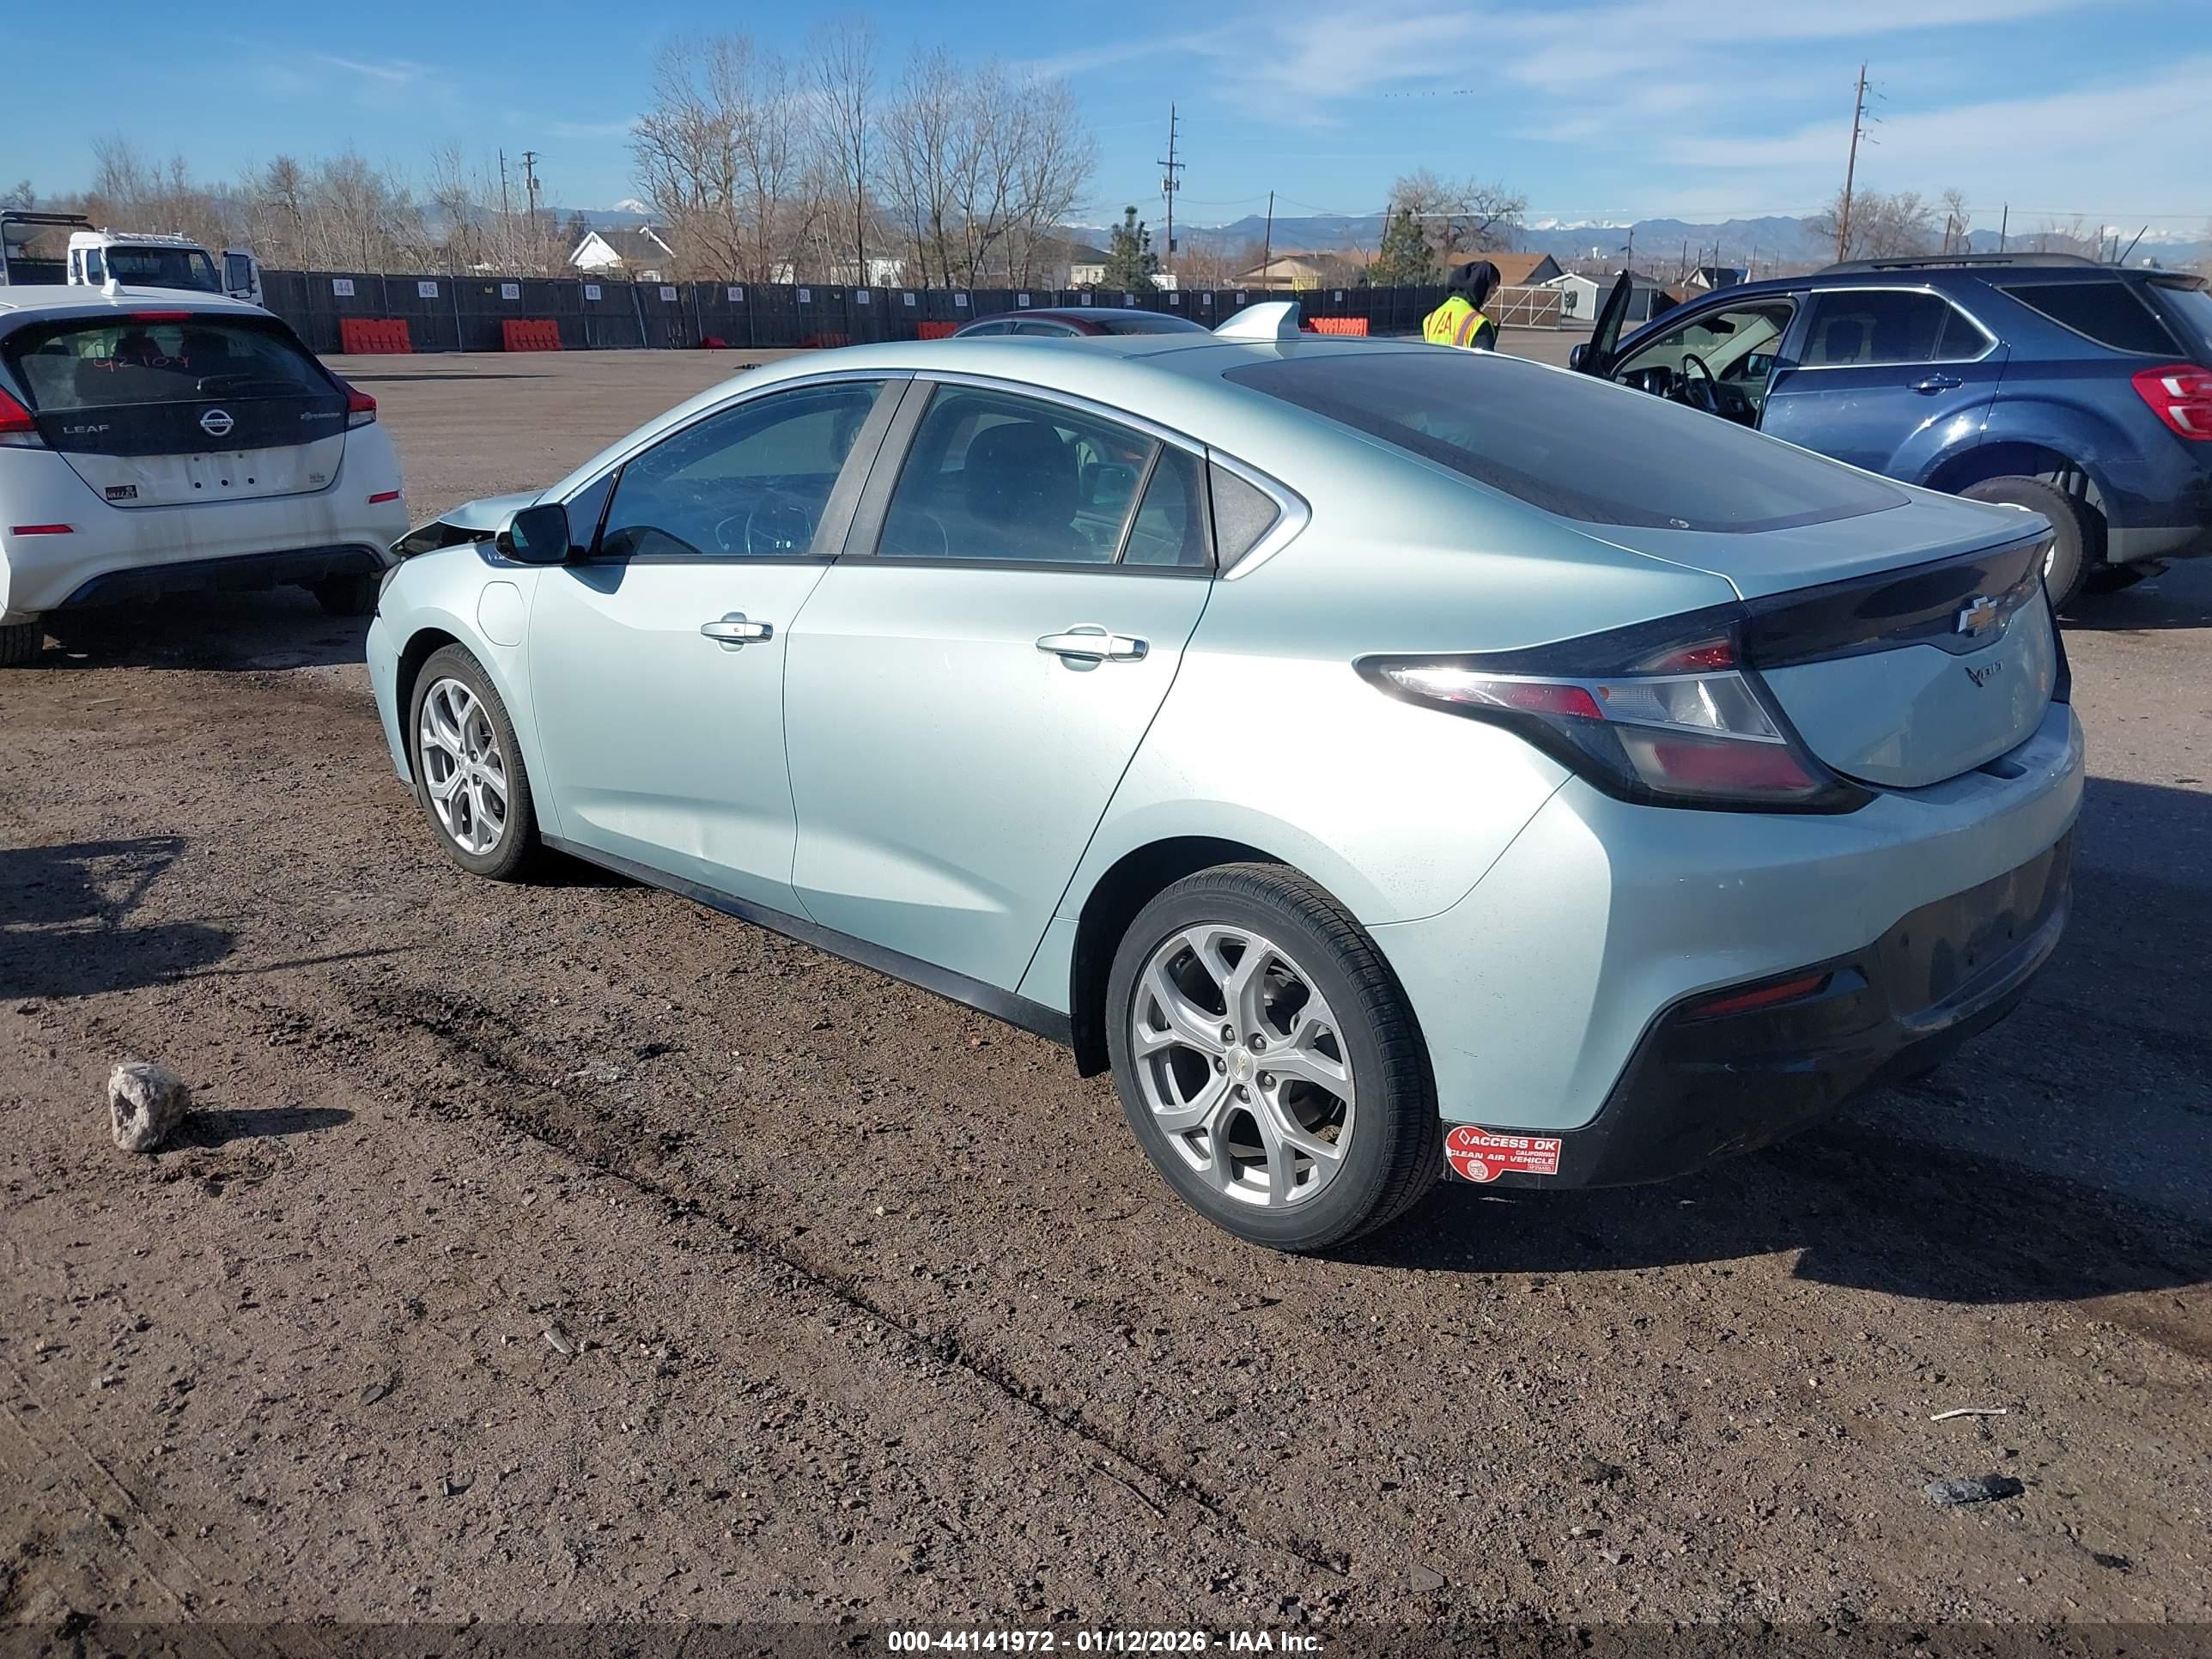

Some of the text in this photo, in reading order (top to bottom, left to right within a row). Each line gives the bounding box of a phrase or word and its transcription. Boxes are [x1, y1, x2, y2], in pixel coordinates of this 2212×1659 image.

[337, 282, 351, 294] 44
[422, 284, 435, 295] 45
[505, 286, 517, 297] 46
[587, 287, 599, 297] 47
[663, 289, 674, 299] 48
[730, 289, 741, 300] 49
[64, 424, 110, 434] LEAF
[1470, 1136, 1557, 1151] ACCESS OK
[1449, 1149, 1555, 1165] CLEAN AIR VEHICLE
